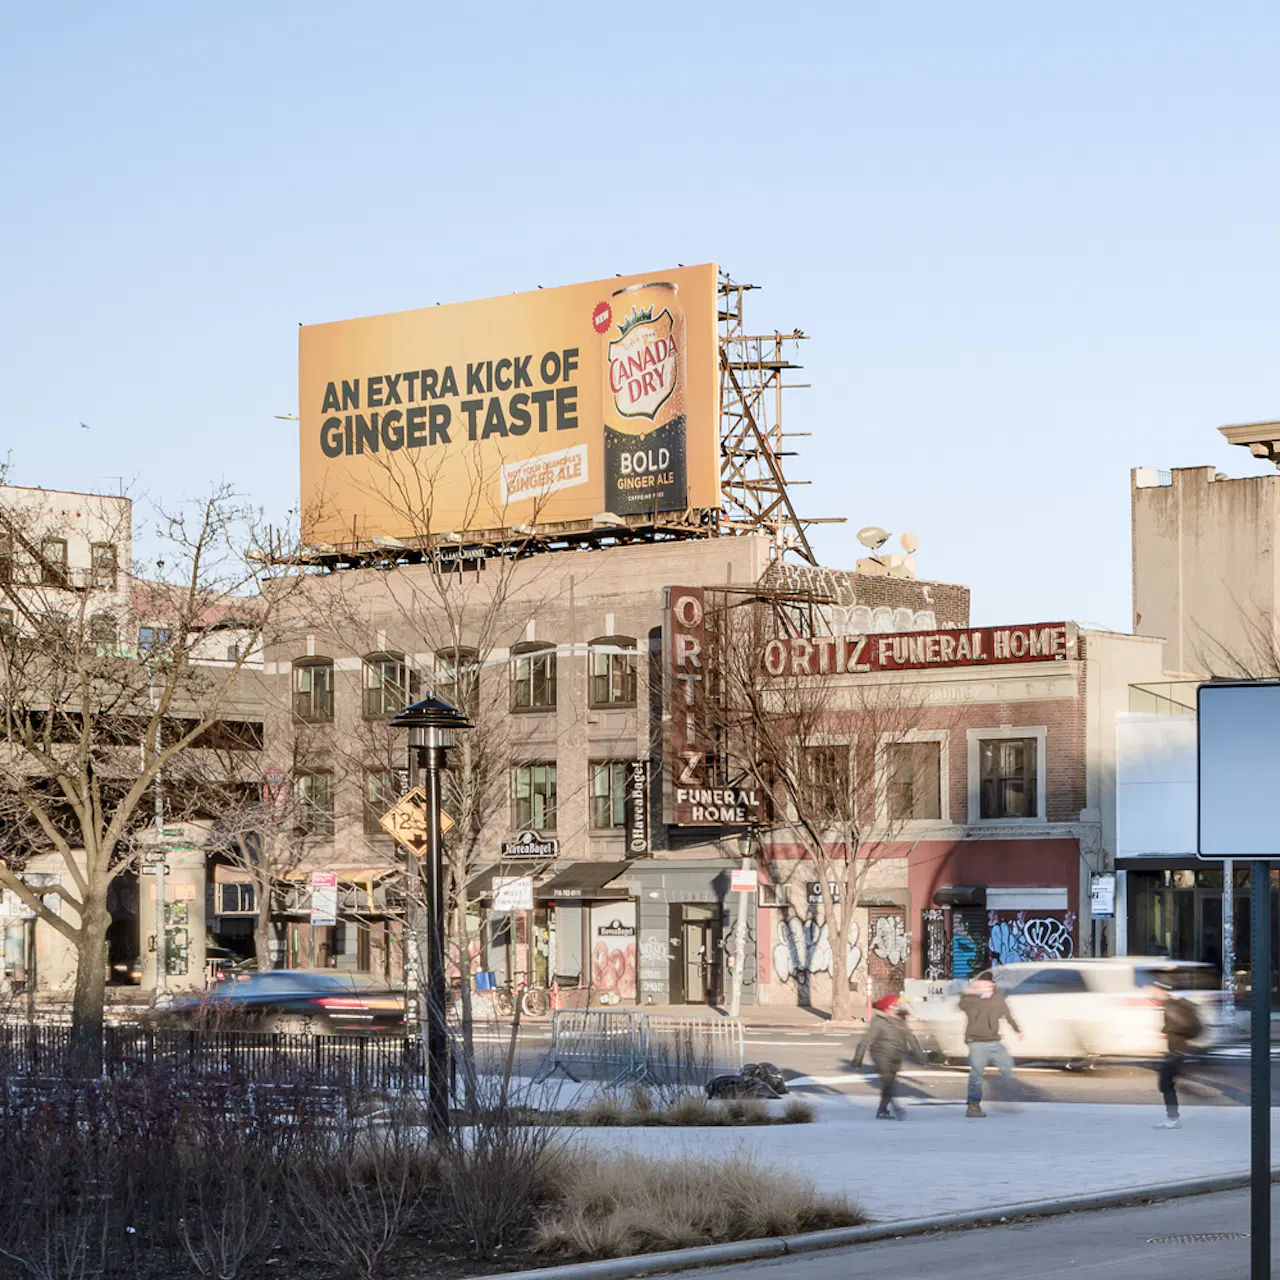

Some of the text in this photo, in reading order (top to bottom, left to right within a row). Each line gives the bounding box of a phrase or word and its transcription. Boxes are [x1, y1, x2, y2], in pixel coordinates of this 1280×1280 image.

[594, 310, 609, 326] NEW
[321, 347, 579, 414] AN EXTRA KICK OF
[609, 333, 677, 394] CANADA
[627, 363, 665, 403] DRY
[320, 385, 579, 459] GINGER TASTE
[507, 461, 582, 496] GINGER ALE
[523, 463, 542, 476] YOUR
[542, 453, 582, 471] GRANDMA'S
[620, 447, 671, 475] BOLD
[617, 471, 674, 490] GINGER ALE
[763, 633, 870, 677] ORTIZ
[878, 628, 988, 666] FUNERAL
[993, 626, 1066, 660] HOME
[673, 595, 703, 784] ORTIZ
[676, 789, 760, 806] FUNERAL
[692, 807, 746, 821] HOME
